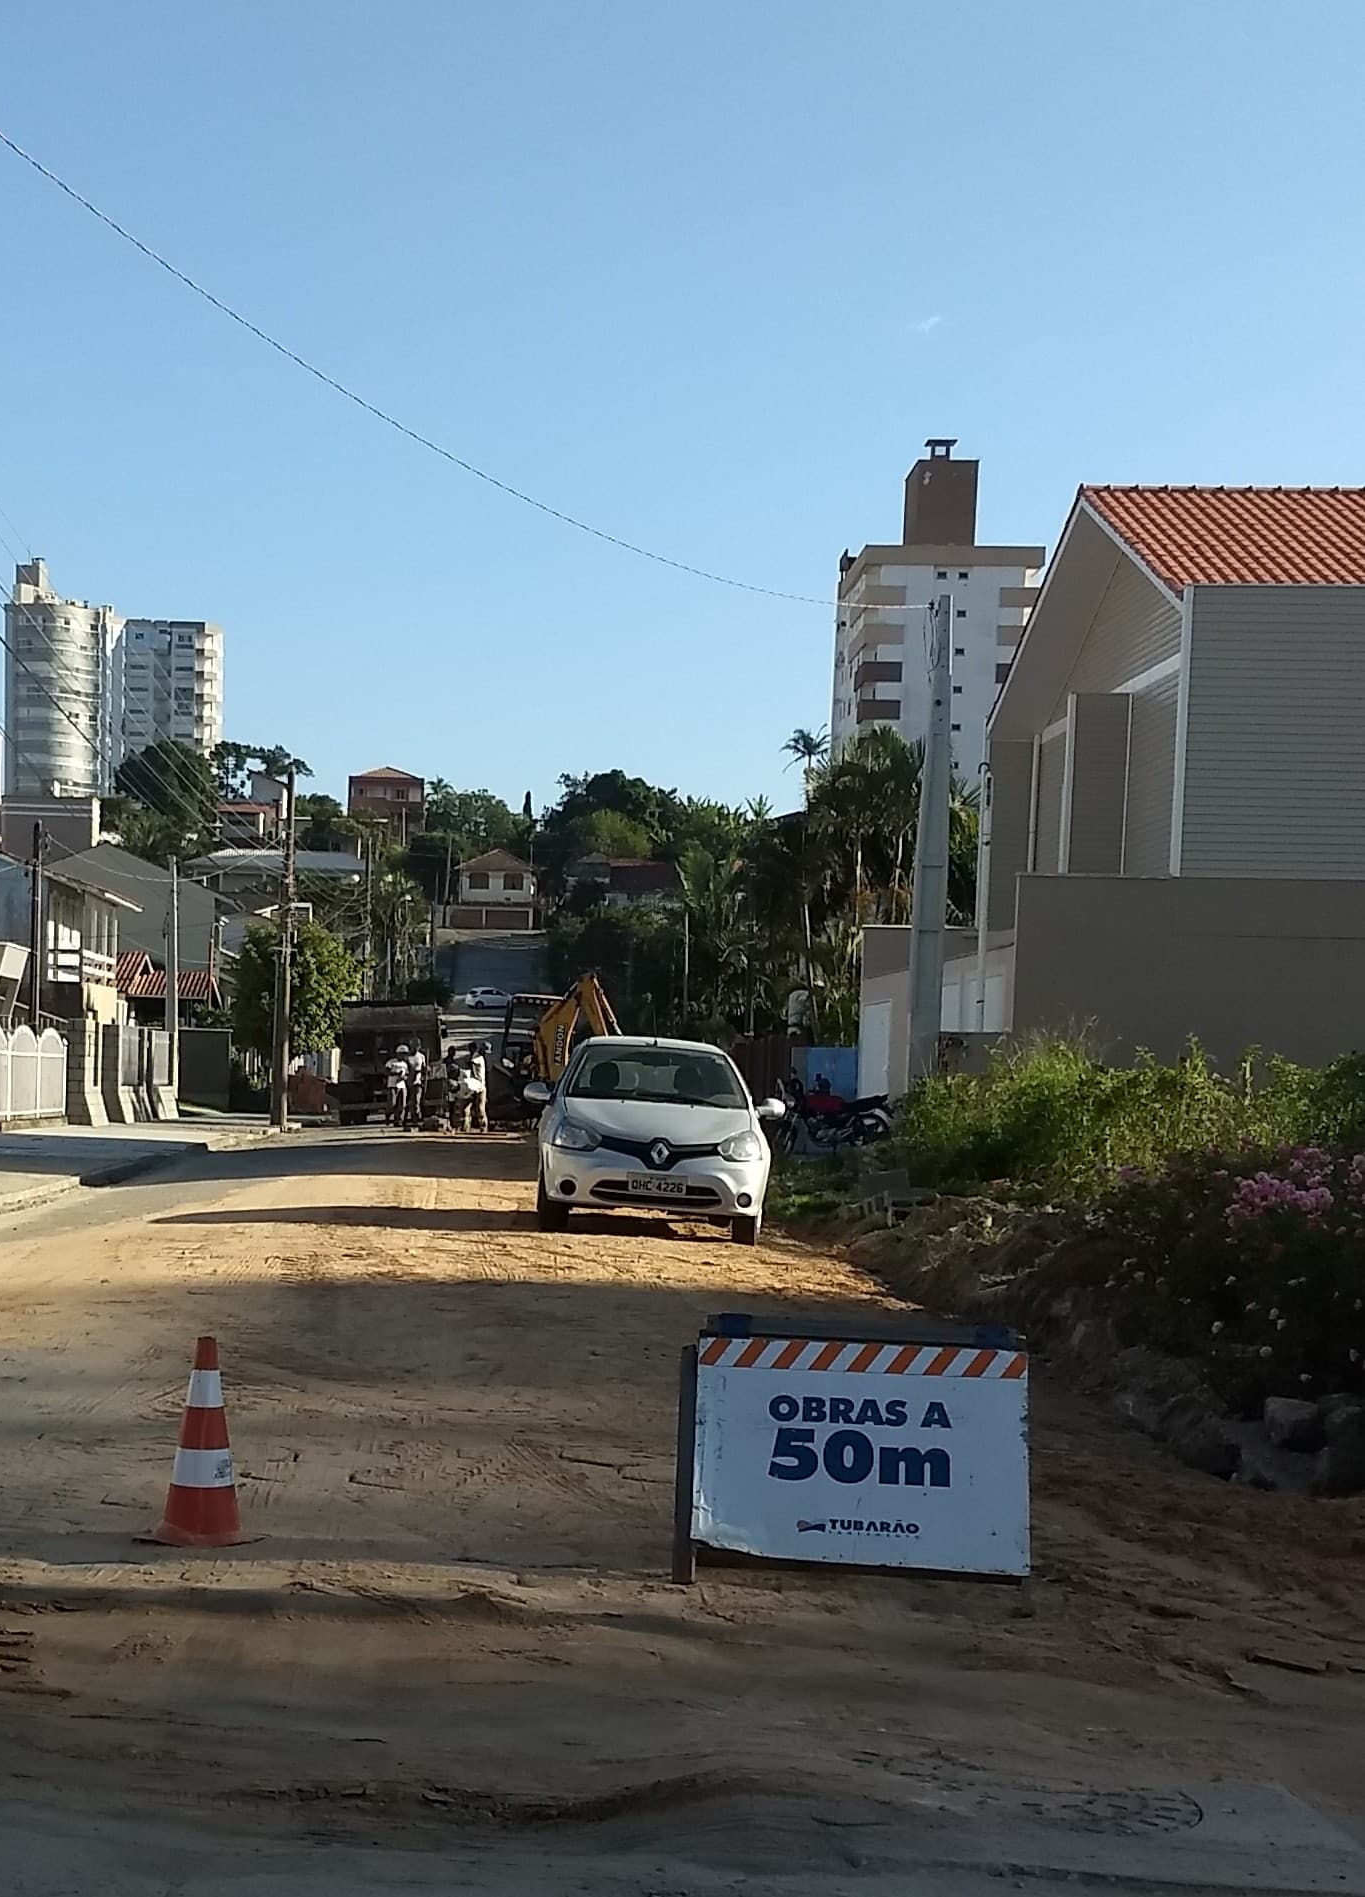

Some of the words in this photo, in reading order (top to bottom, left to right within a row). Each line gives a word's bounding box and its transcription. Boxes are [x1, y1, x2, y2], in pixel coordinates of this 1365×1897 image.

[768, 1395, 908, 1427] OBRAS
[920, 1401, 952, 1429] A
[768, 1427, 951, 1488] 50m
[829, 1518, 920, 1534] TUBARÃO
